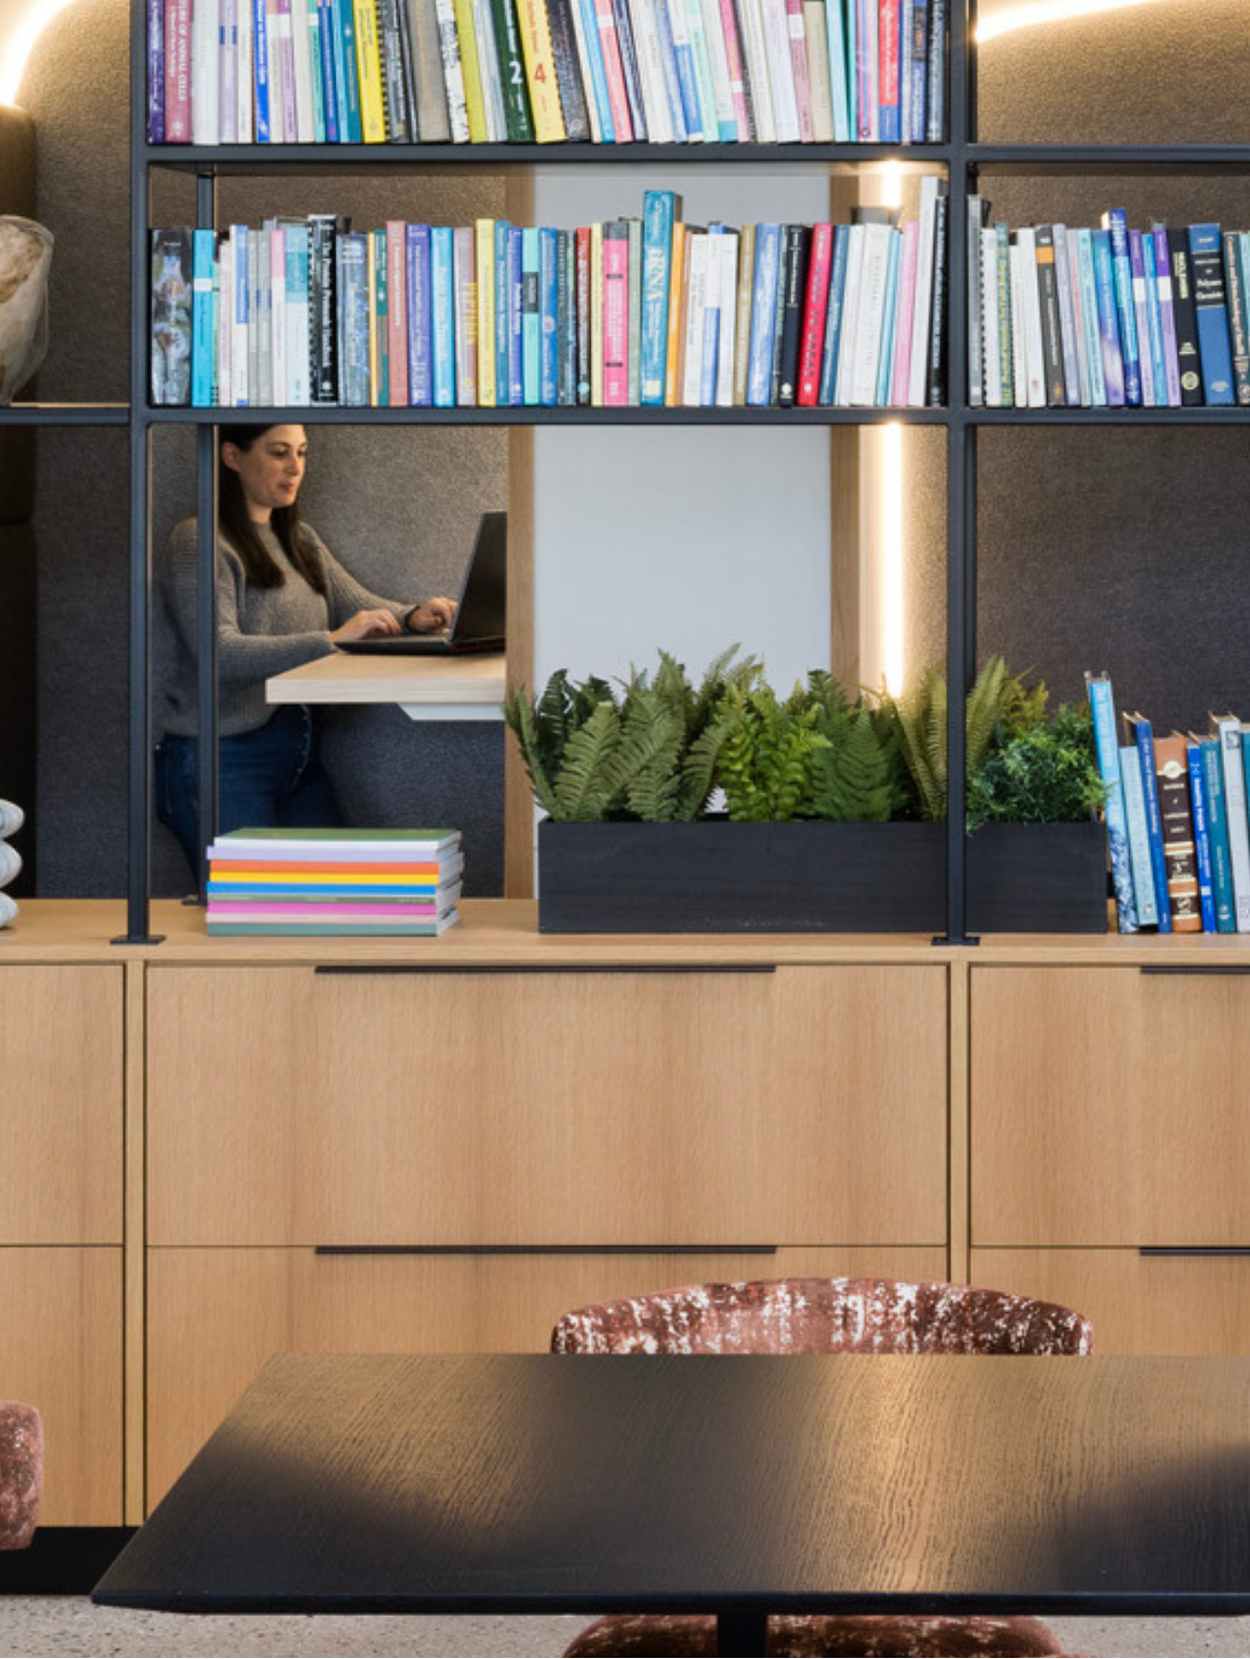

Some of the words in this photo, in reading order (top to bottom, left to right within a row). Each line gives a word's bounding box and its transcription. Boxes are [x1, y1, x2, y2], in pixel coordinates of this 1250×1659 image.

[177, 24, 187, 35] OF
[177, 37, 187, 70] ANIMAL
[508, 60, 522, 84] 2
[531, 62, 547, 84] 4
[178, 74, 188, 100] CELLS
[322, 241, 331, 255] The
[322, 258, 331, 286] Protein
[646, 248, 665, 301] tRNA
[810, 264, 823, 303] GOOD
[322, 290, 331, 325] Protocols
[808, 310, 819, 327] TO
[322, 329, 331, 367] Handbook
[804, 332, 817, 377] GREAT
